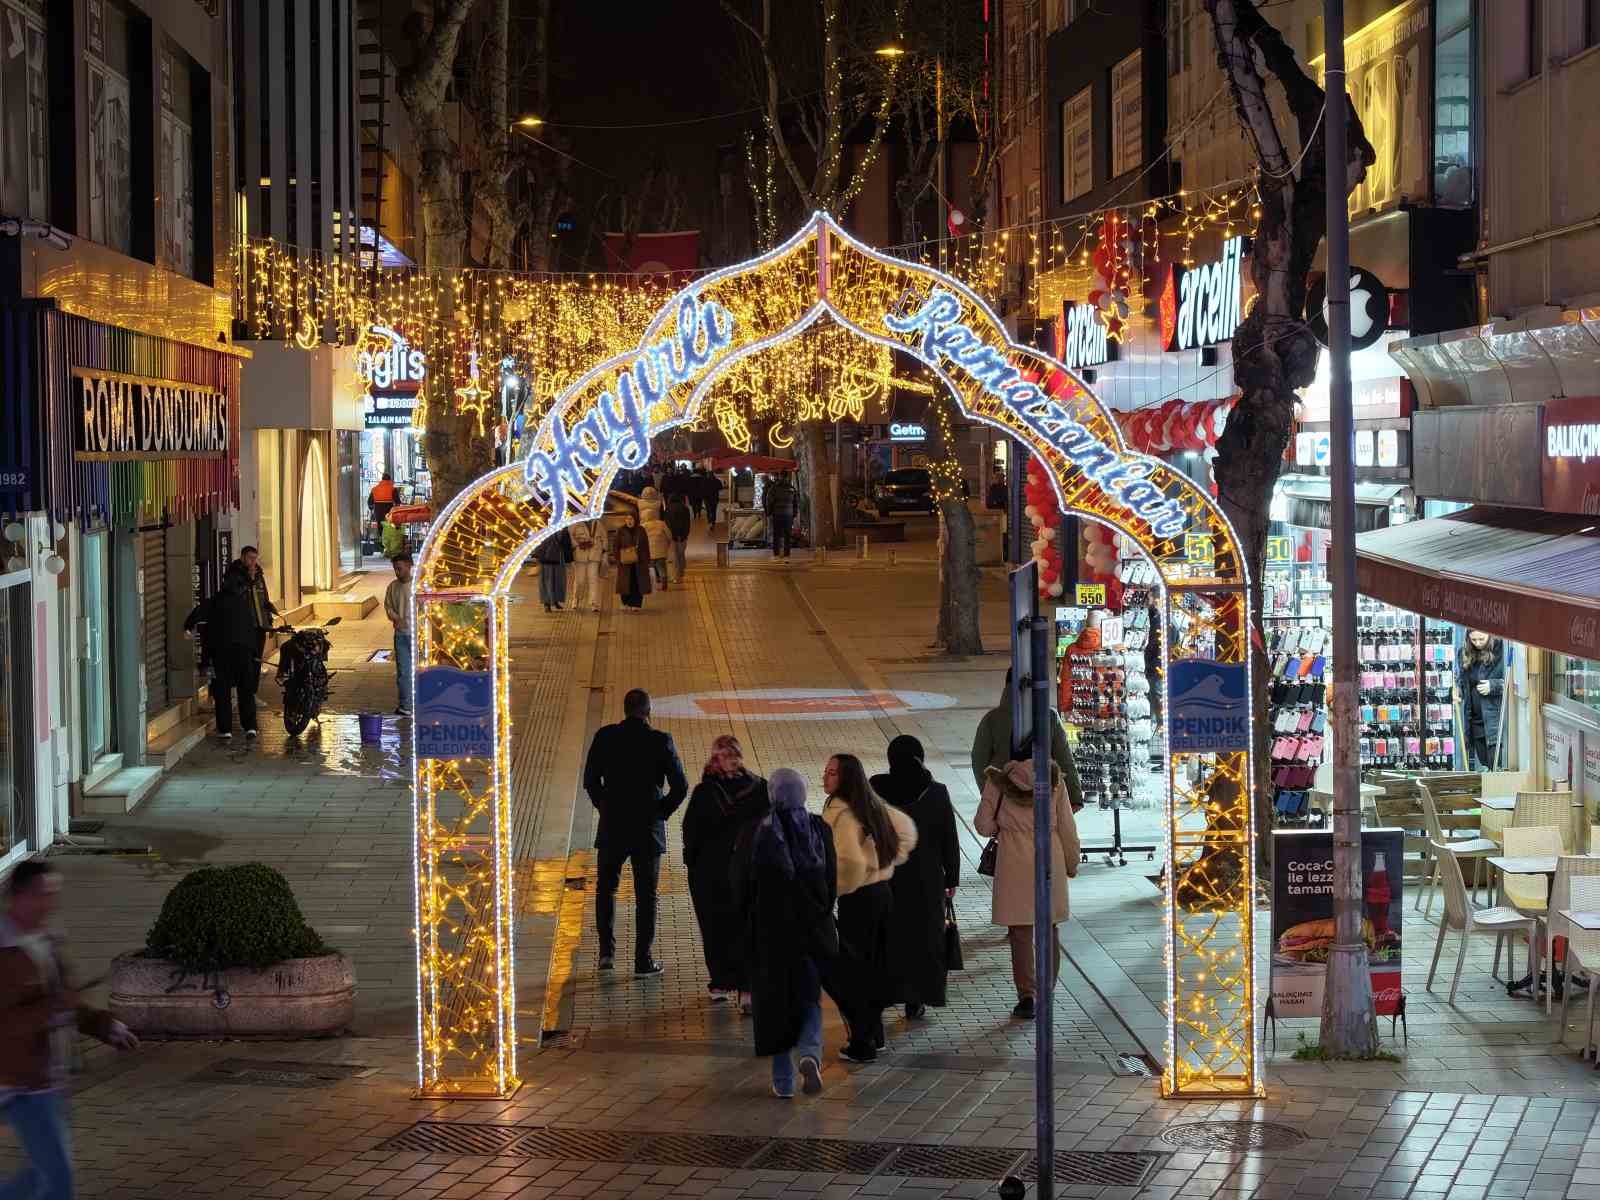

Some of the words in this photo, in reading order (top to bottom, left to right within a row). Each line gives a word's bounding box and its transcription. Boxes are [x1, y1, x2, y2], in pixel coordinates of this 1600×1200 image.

[83, 377, 136, 451] ROMA
[884, 289, 1187, 538] Ramazanlar
[1081, 592, 1102, 604] 550
[1288, 872, 1303, 882] ile
